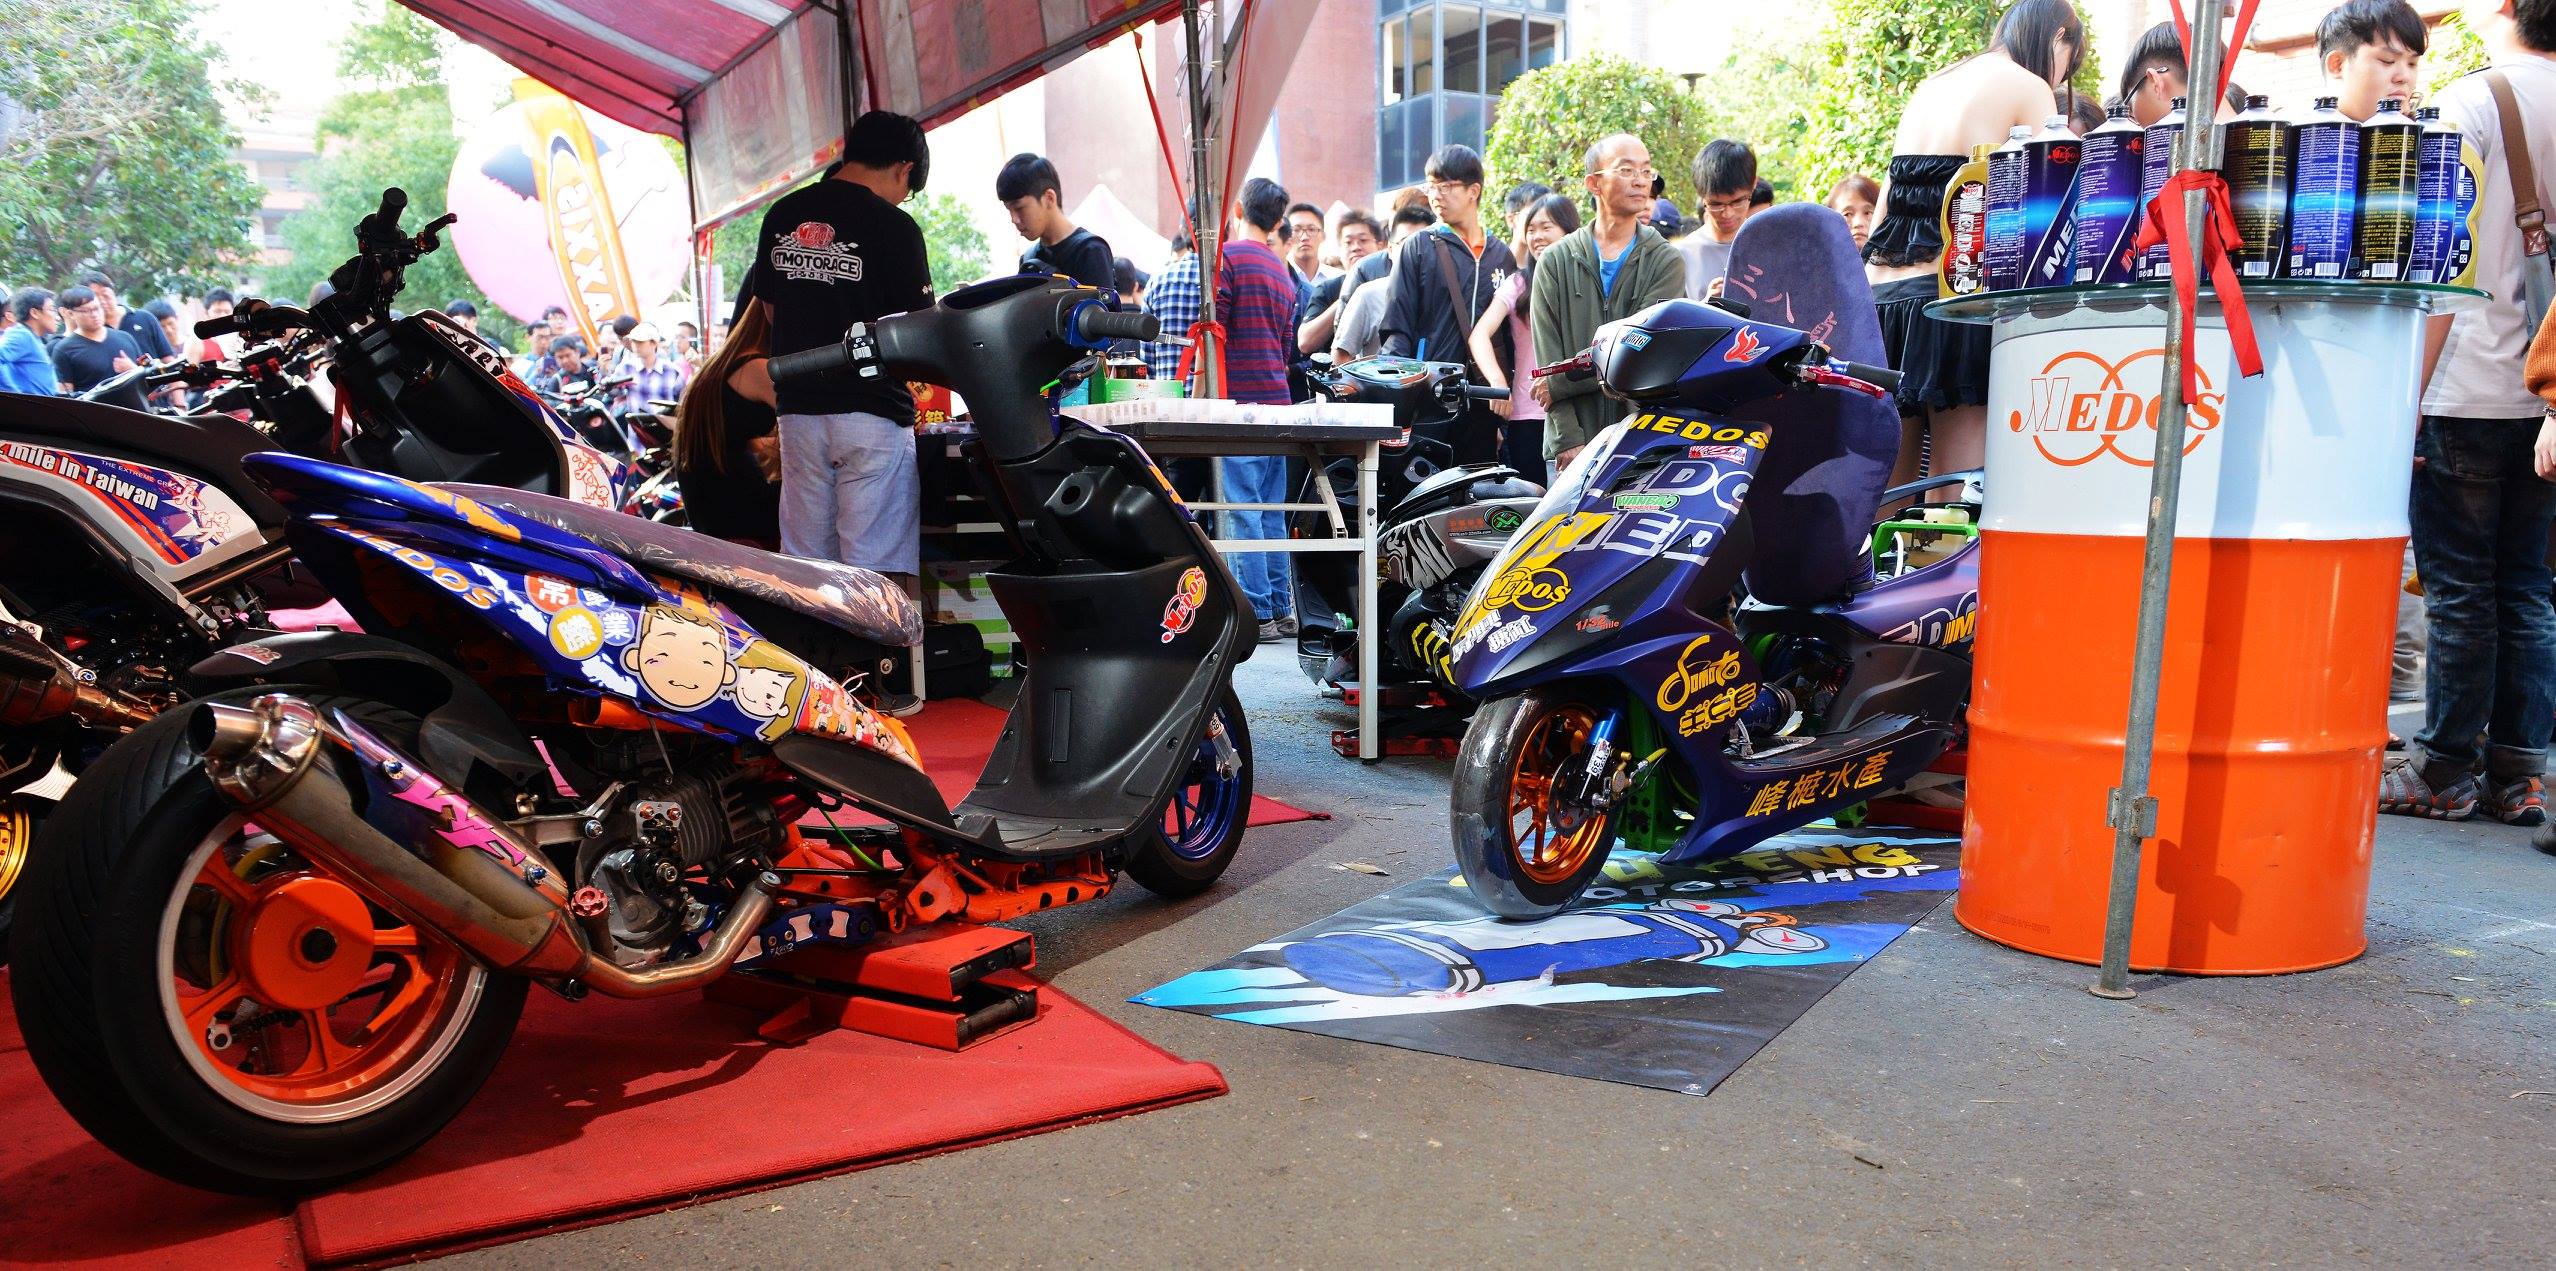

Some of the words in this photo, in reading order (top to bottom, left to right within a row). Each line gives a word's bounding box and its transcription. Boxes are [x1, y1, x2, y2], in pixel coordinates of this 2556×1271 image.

[556, 180, 617, 325] AXXIS
[1628, 414, 1769, 450] MEDOS
[8, 442, 56, 470] mile
[59, 456, 81, 480] In
[85, 464, 158, 511] Taiwan
[101, 460, 116, 469] THE
[118, 465, 156, 483] EXTREME
[1161, 568, 1206, 643] MEDOS
[1484, 572, 1572, 604] MEDOS
[1582, 864, 1940, 900] OTORSHOP
